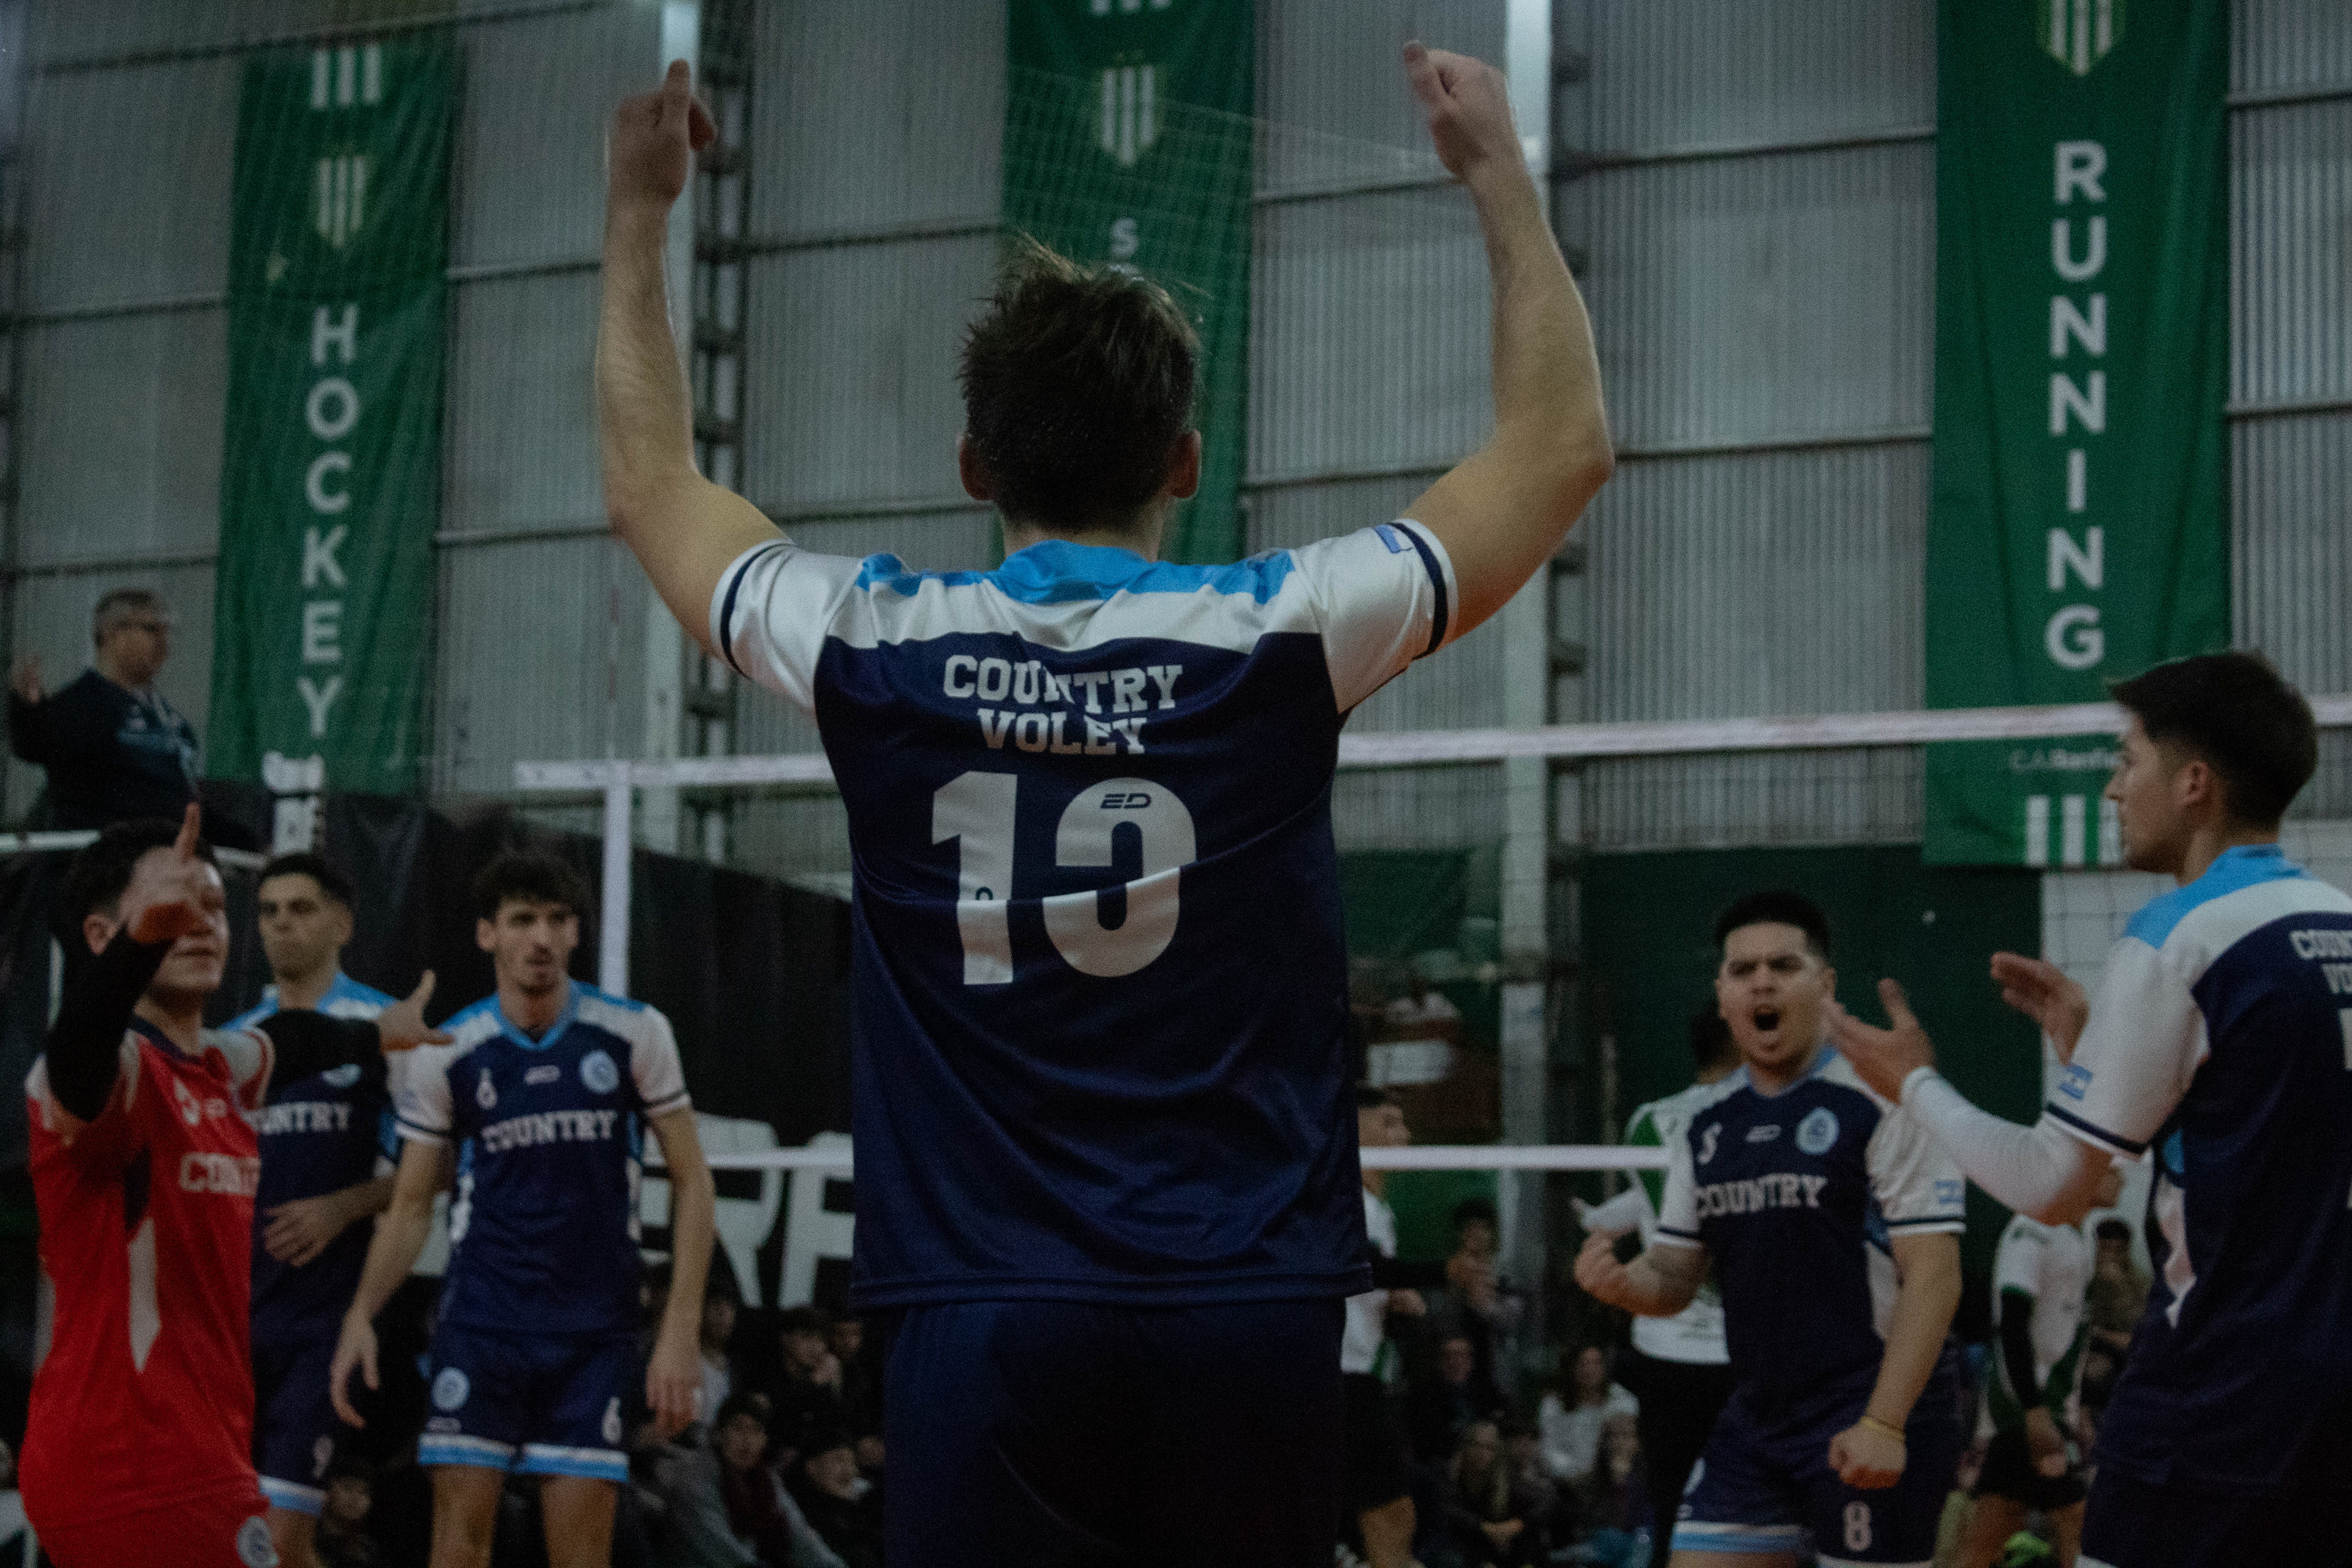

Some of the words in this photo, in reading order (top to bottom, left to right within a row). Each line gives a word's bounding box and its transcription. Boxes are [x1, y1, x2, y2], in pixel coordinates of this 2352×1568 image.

[2045, 140, 2108, 670] RUNNING
[297, 304, 361, 739] HOCKEY
[943, 654, 1183, 714] COUNTRY
[977, 708, 1147, 755] VOLEY
[931, 770, 1197, 986] 13
[480, 1108, 618, 1153] COUNTRY
[1842, 1500, 1872, 1552] 8
